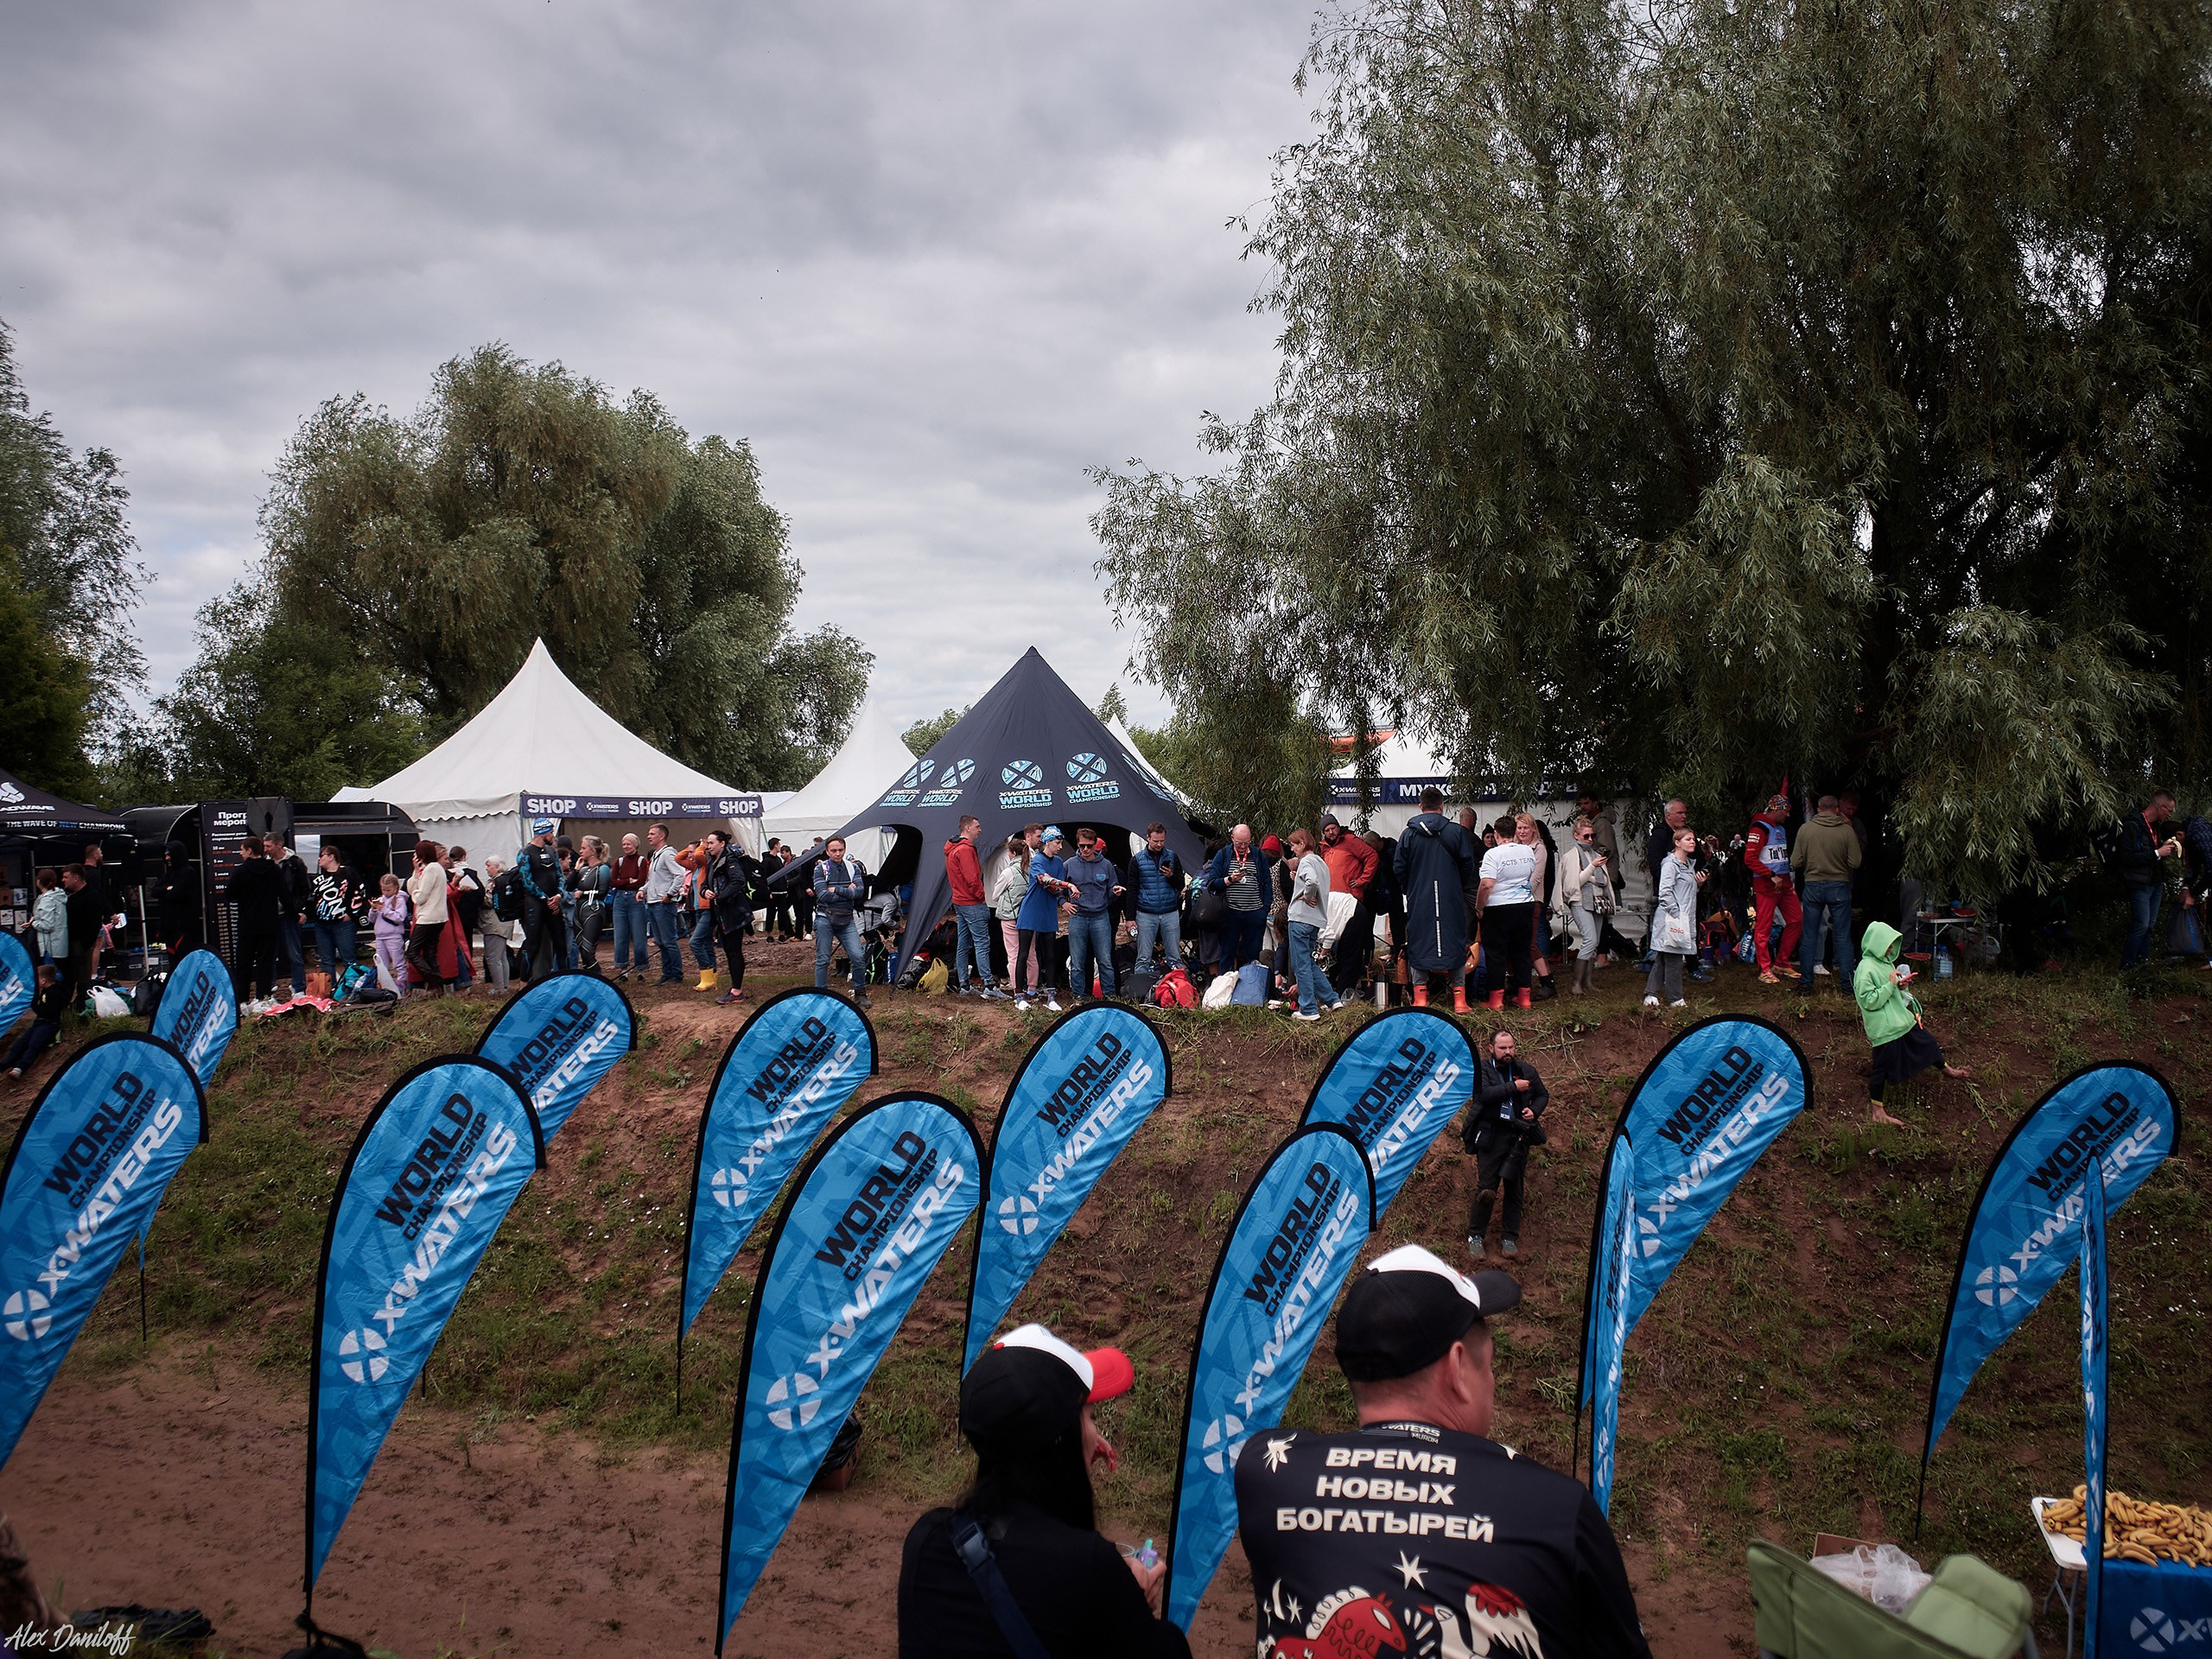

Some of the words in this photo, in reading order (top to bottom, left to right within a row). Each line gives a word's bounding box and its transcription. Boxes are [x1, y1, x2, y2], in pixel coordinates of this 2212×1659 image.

[526, 798, 577, 814] SHOP
[628, 800, 673, 815] SHOP
[719, 800, 759, 815] SHOP
[883, 794, 917, 803] WORLD
[921, 794, 959, 803] WORLD
[998, 794, 1052, 804] WORLD
[1066, 785, 1119, 799] WORLD
[170, 970, 209, 1046] WORLD
[507, 997, 588, 1081] WORLD
[746, 1016, 826, 1103] WORLD
[765, 1032, 837, 1114] CHAMPIONSHIP
[1036, 1033, 1122, 1127] WORLD
[1057, 1049, 1132, 1138] CHAMPIONSHIP
[1344, 1038, 1426, 1136] WORLD
[1359, 1051, 1436, 1147] CHAMPIONSHIP
[1656, 1046, 1751, 1145] WORLD
[43, 1071, 143, 1195] WORLD
[68, 1088, 156, 1210] CHAMPIONSHIP
[1680, 1062, 1764, 1156] CHAMPIONSHIP
[2025, 1091, 2130, 1191] WORLD
[375, 1093, 474, 1227] WORLD
[403, 1112, 487, 1241] CHAMPIONSHIP
[814, 1131, 926, 1268] WORLD
[843, 1147, 938, 1281] CHAMPIONSHIP
[1244, 1162, 1331, 1305] WORLD
[1265, 1179, 1340, 1317] CHAMPIONSHIP
[1325, 1447, 1457, 1476] ВРЕМЯ
[1411, 1432, 1440, 1444] MUROM
[1276, 1508, 1494, 1543] БОГАТЫРЕЙ
[1316, 1475, 1456, 1505] НОВЫХ
